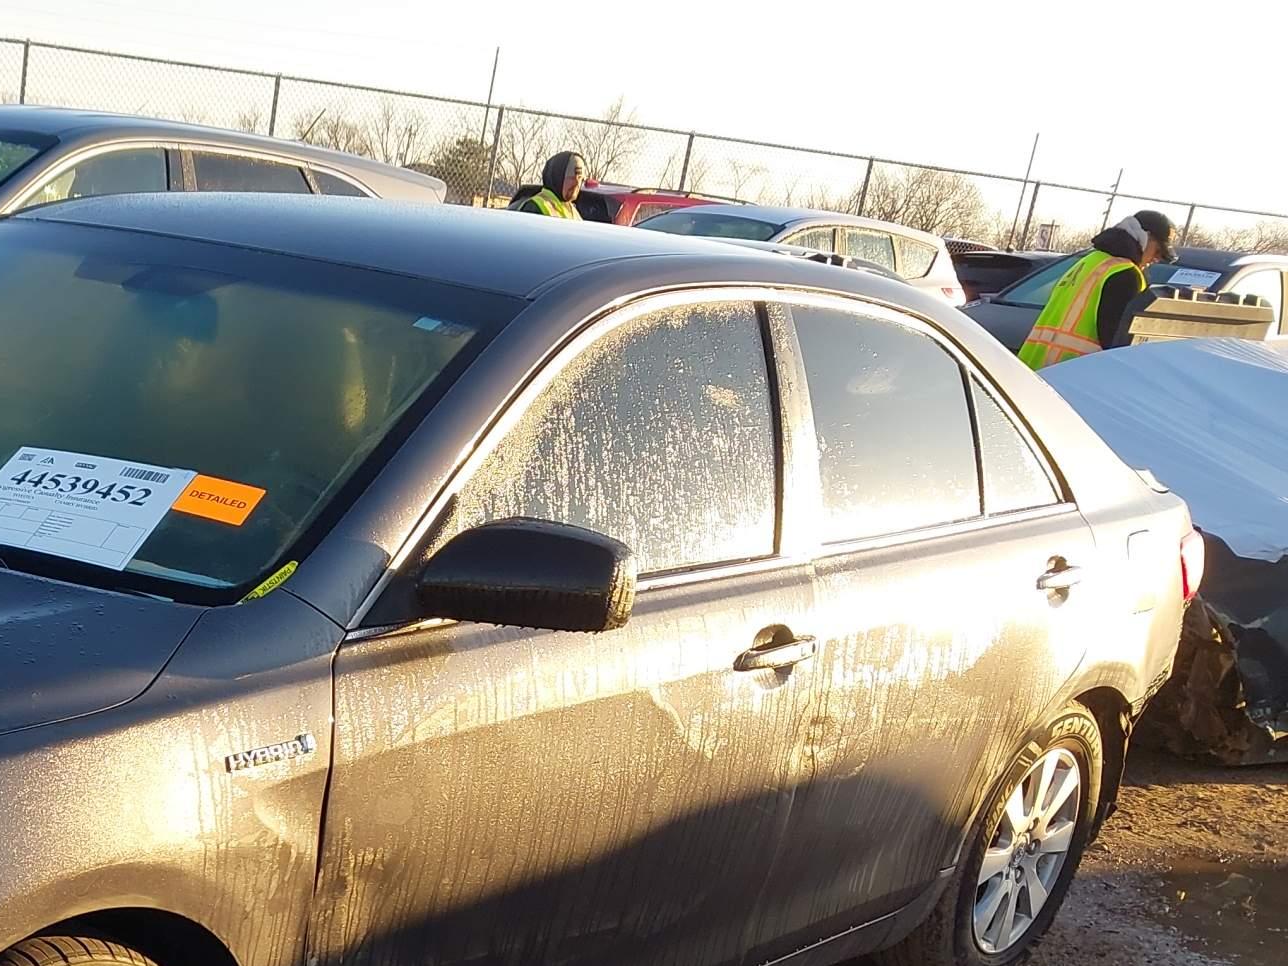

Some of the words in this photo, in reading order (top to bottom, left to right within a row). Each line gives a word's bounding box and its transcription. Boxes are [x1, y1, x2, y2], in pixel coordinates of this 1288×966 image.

[11, 469, 152, 506] 44539452
[189, 489, 247, 509] DETAILED
[225, 736, 305, 773] HYBRID
